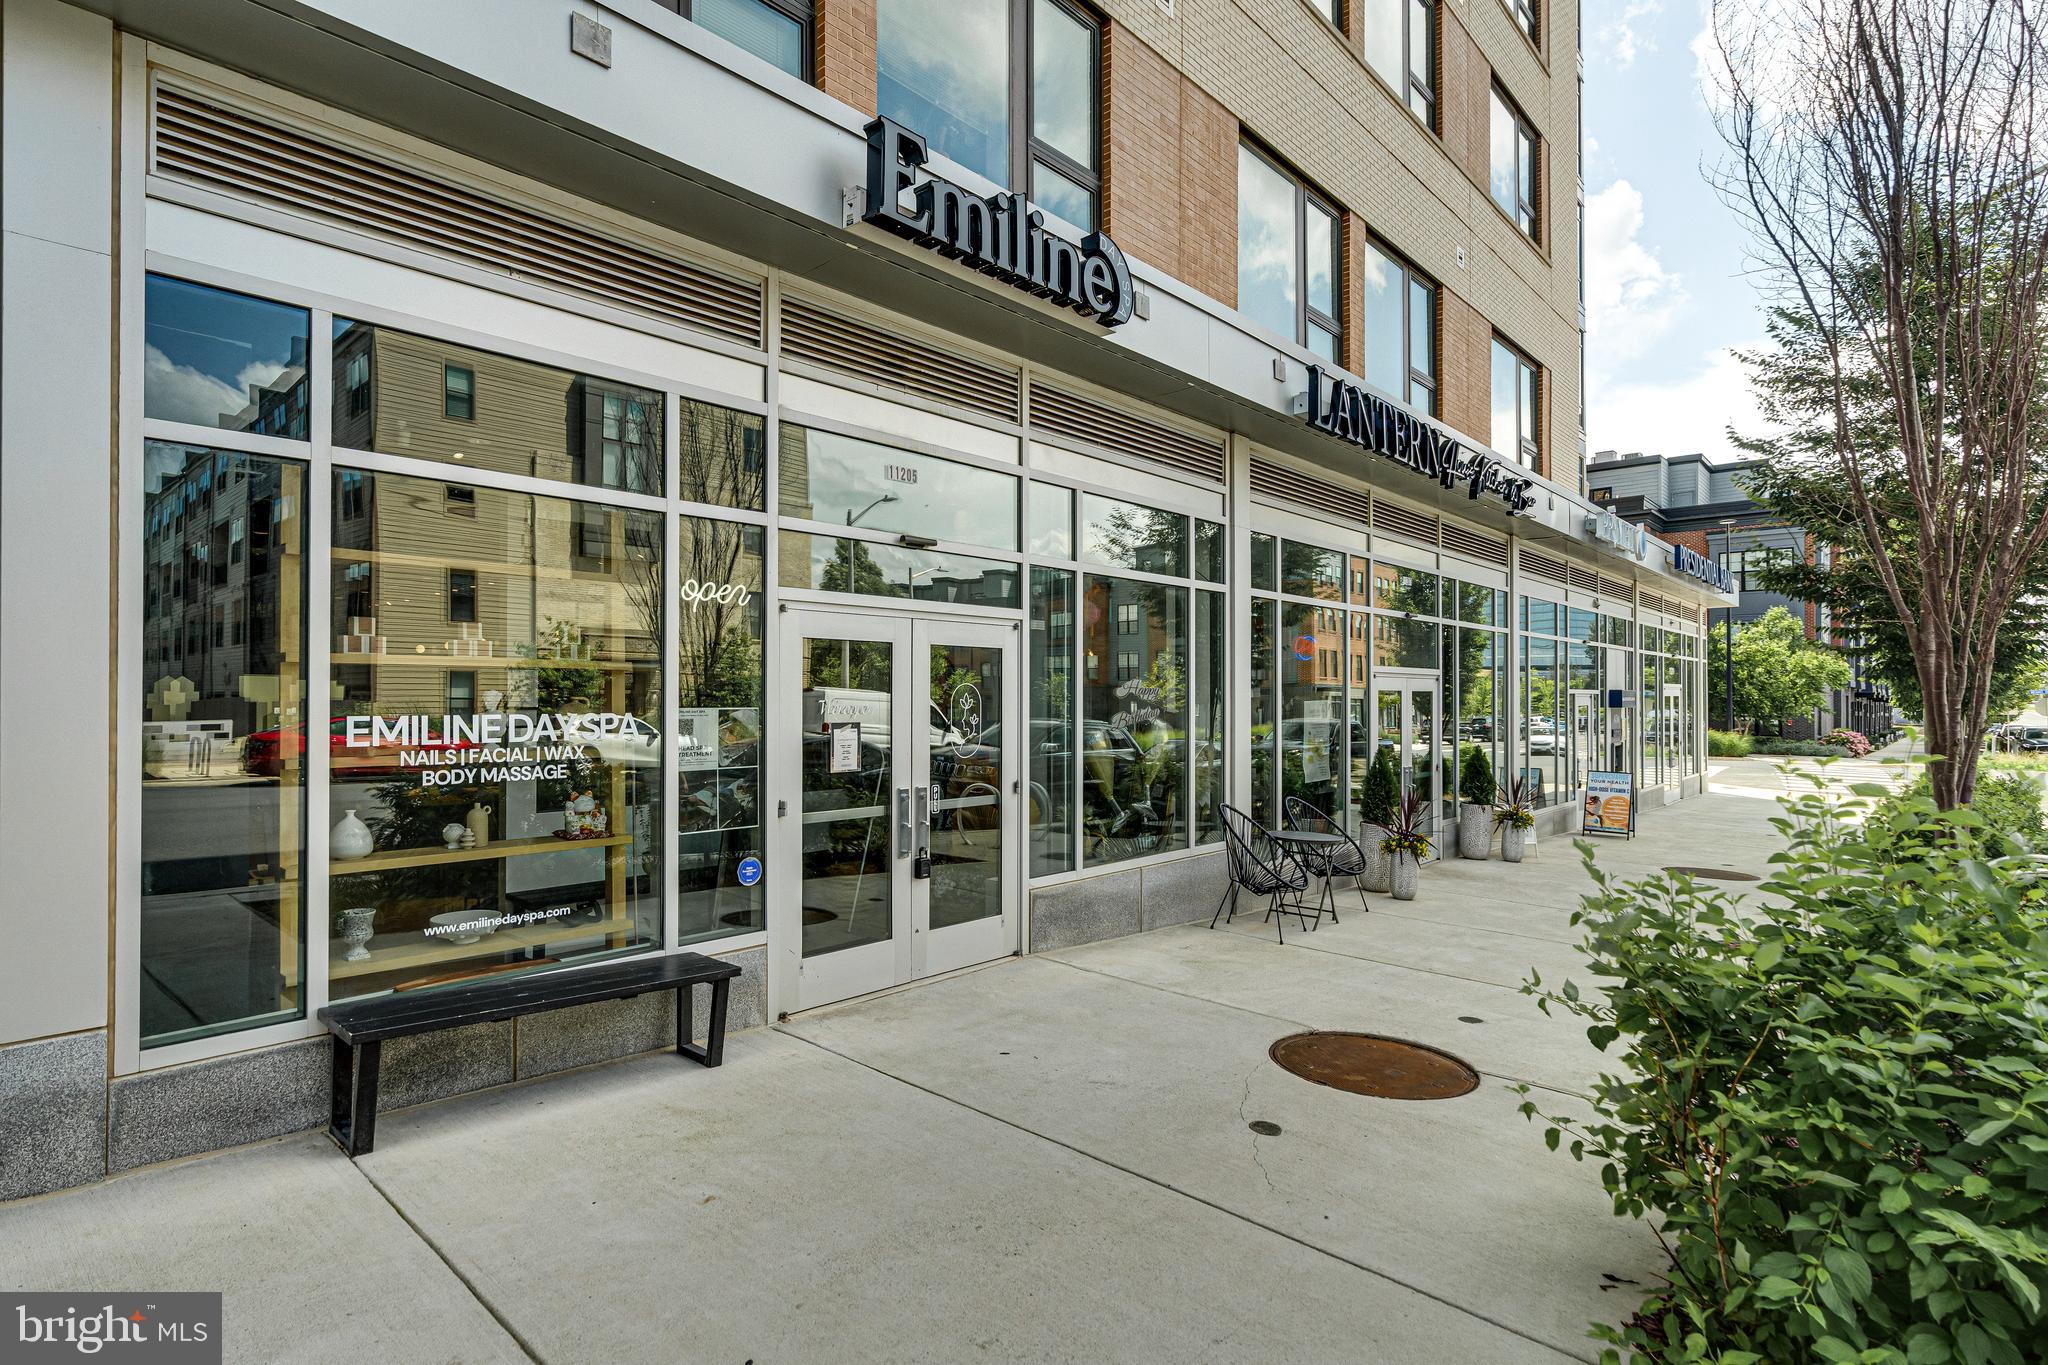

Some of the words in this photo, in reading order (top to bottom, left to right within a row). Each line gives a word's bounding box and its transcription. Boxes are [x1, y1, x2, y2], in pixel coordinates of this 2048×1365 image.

[865, 115, 1115, 316] Emiline
[1099, 236, 1125, 267] DAY
[1118, 280, 1132, 318] SPA
[1307, 364, 1443, 479] LANTERN
[889, 465, 918, 483] 11205
[1680, 544, 1721, 589] PRESIDENTIAL
[680, 579, 752, 613] open
[1116, 679, 1160, 703] Happy
[346, 713, 502, 748] EMILINE
[508, 713, 578, 743] DAY
[579, 711, 640, 741] SPA
[1110, 705, 1161, 732] Birthday
[400, 749, 457, 767] NAILS
[469, 746, 533, 765] FACIAL
[543, 745, 586, 761] WAX
[422, 768, 475, 787] BODY
[480, 764, 568, 784] MASSAGE
[423, 906, 572, 937] www.emilinedayspa.com
